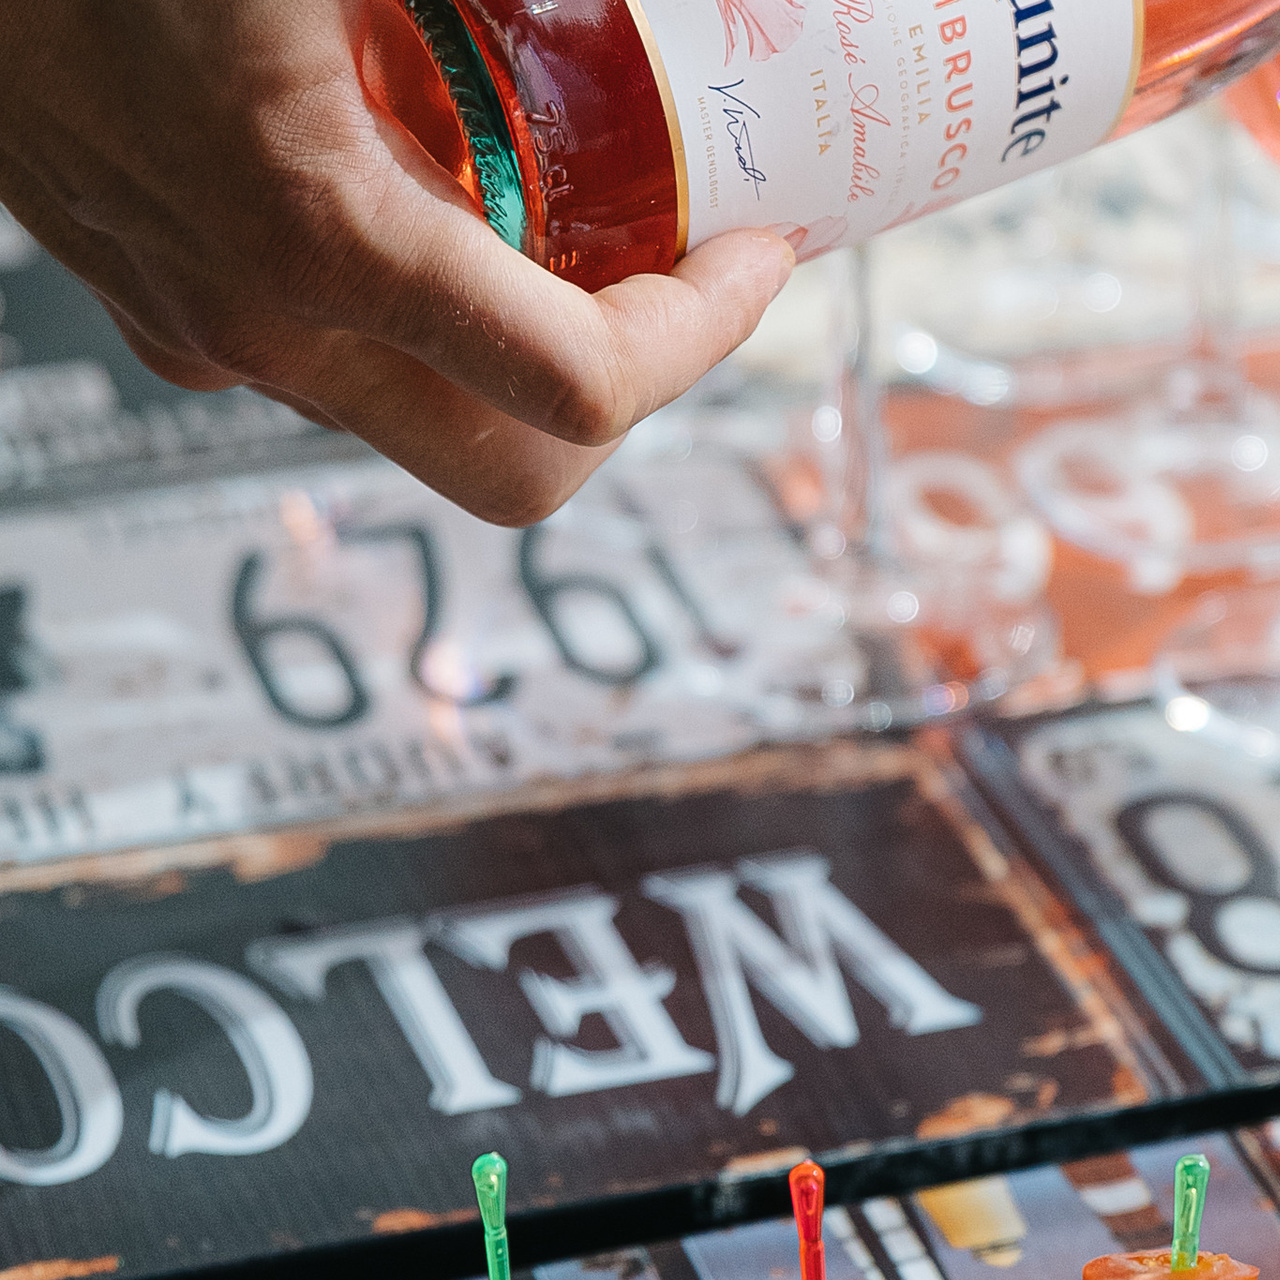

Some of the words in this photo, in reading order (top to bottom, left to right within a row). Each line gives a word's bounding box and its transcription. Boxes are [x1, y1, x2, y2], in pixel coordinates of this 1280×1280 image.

[809, 68, 833, 156] ITALIA
[907, 22, 933, 126] EMILIA
[696, 96, 713, 142] MASTER
